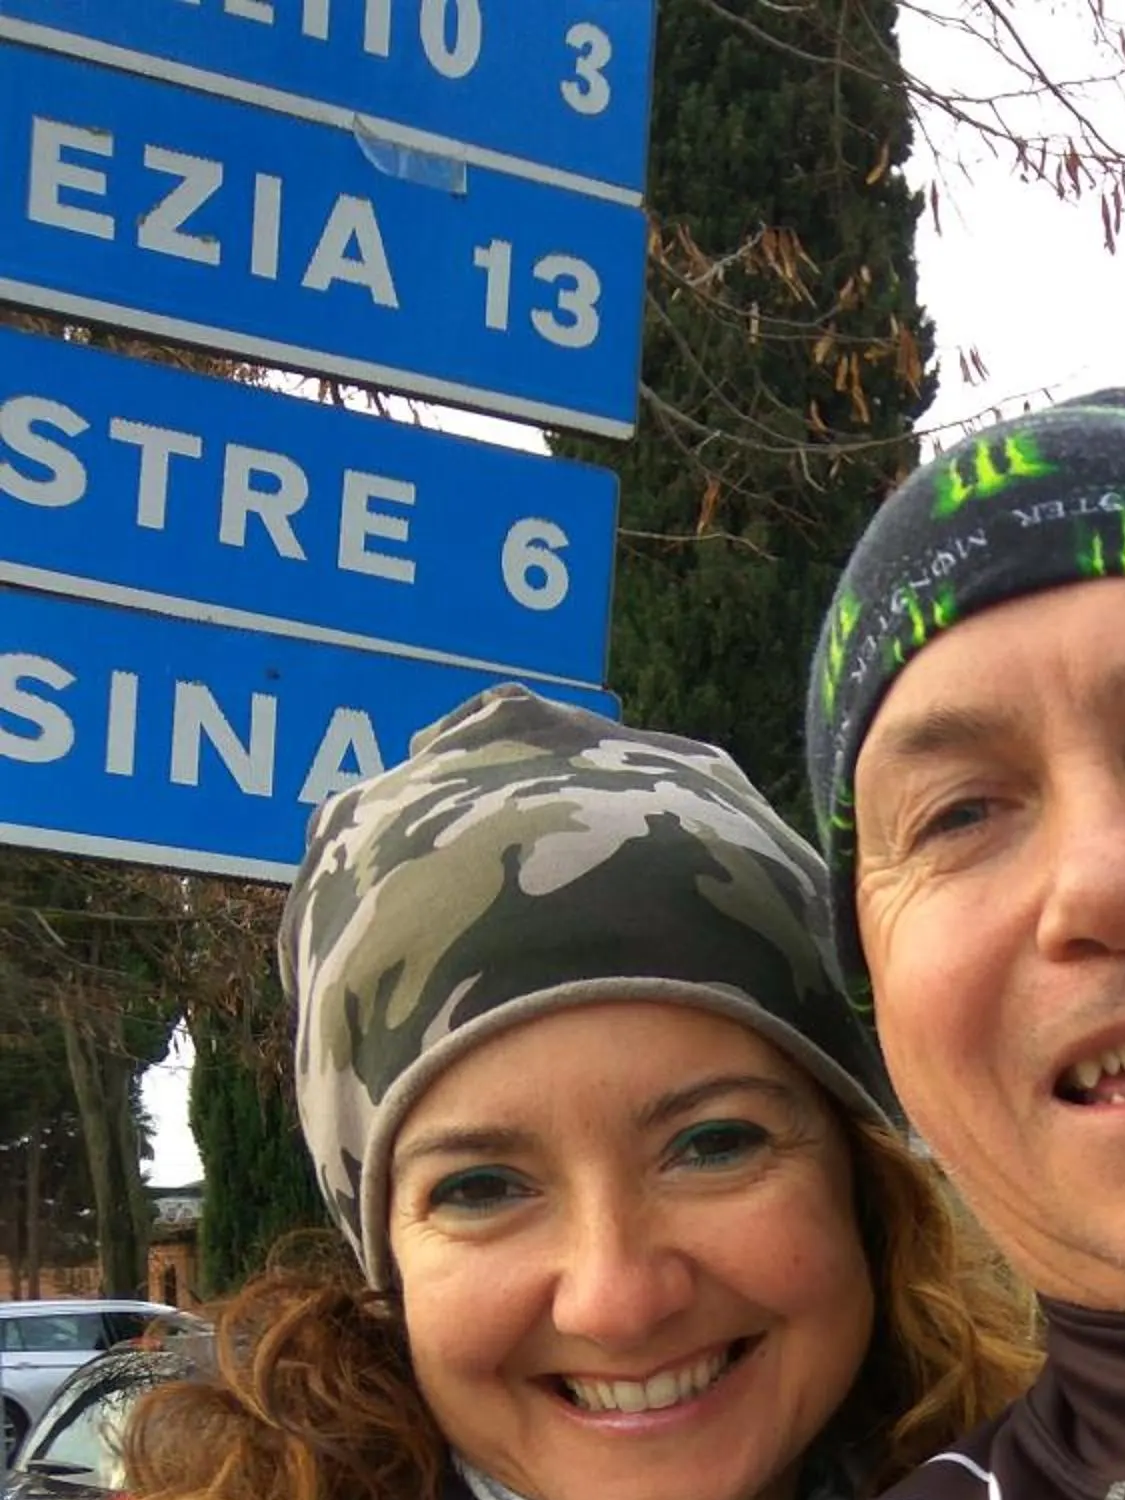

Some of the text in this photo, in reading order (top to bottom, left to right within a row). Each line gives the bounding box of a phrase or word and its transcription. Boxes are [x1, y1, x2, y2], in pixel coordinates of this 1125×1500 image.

[561, 22, 613, 115] 3
[27, 115, 602, 349] EZIA 13
[0, 395, 570, 611] STRE 6
[0, 652, 386, 804] SINA
